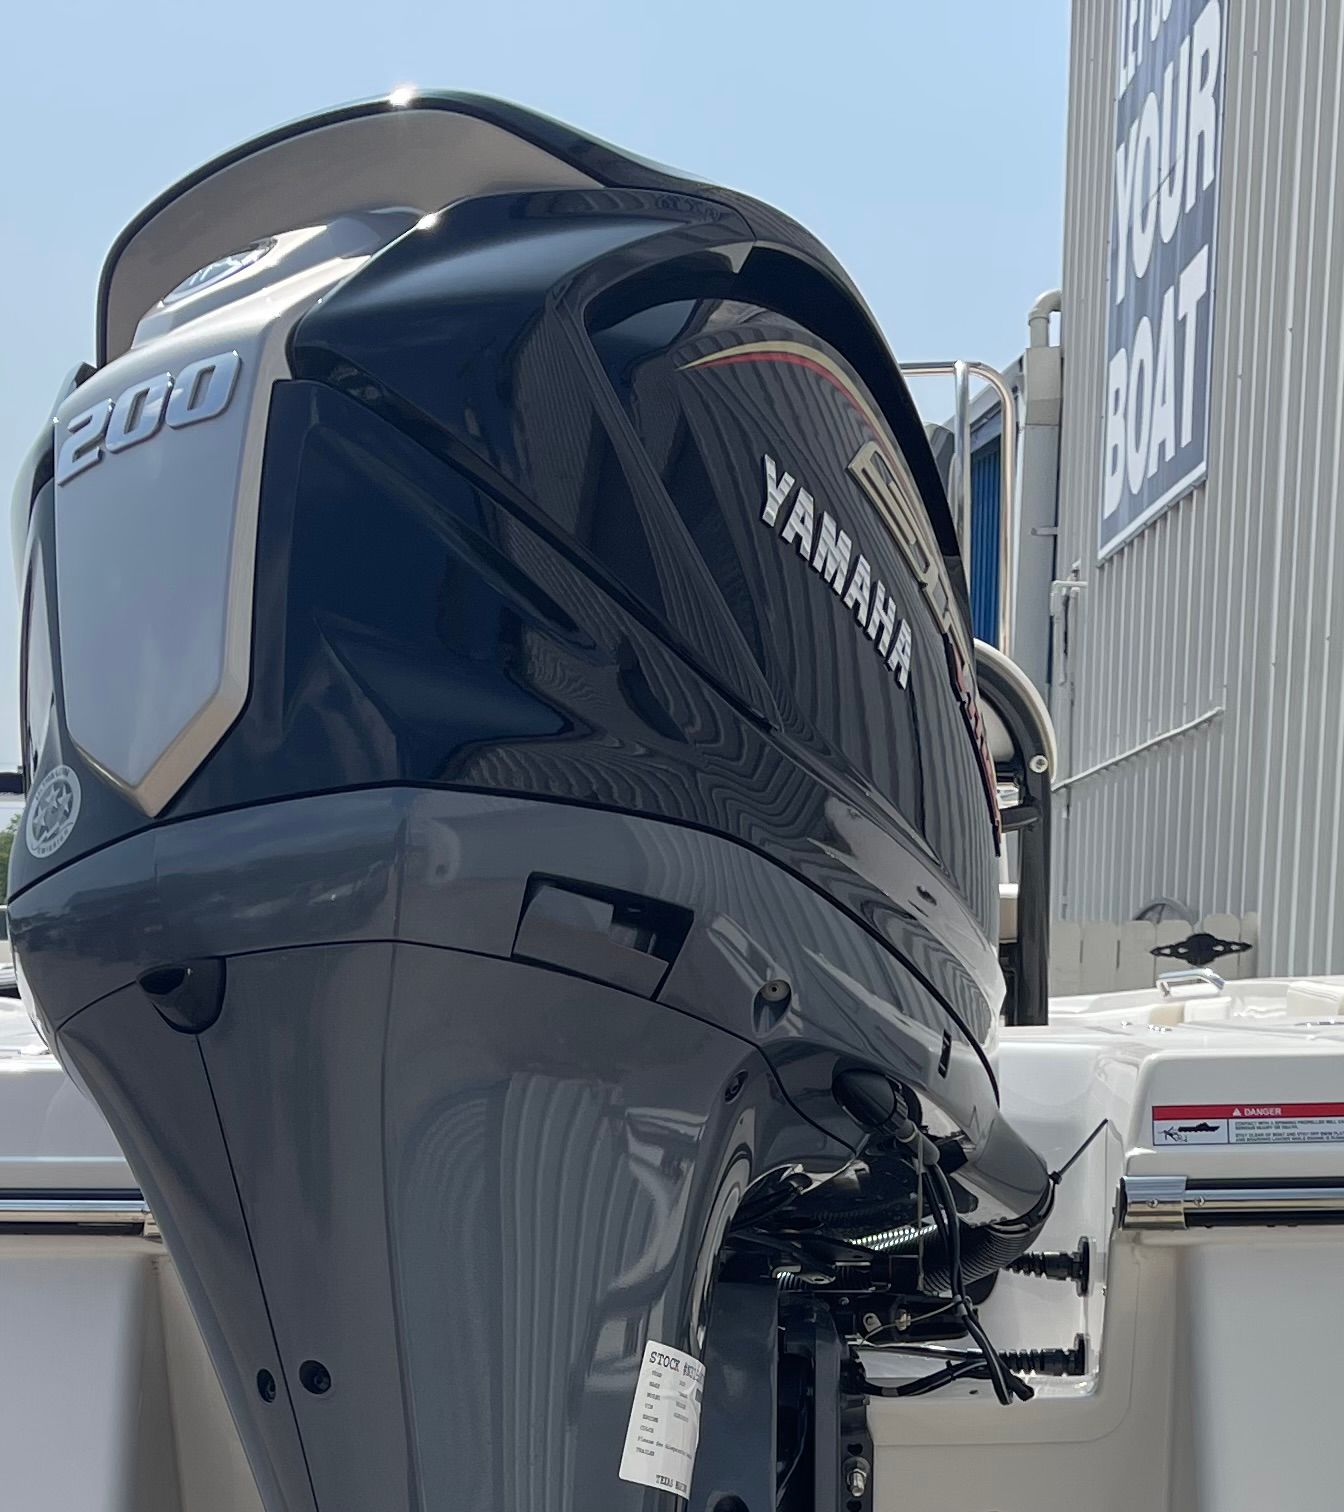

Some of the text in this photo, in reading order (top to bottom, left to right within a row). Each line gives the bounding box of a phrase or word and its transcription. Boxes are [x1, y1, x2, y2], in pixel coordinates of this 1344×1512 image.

[1115, 0, 1221, 305] YOUR
[57, 349, 243, 488] 200
[1103, 244, 1209, 520] BOAT
[760, 453, 913, 691] YAMAHA
[1244, 1108, 1282, 1116] DANGER
[649, 1351, 681, 1373] STOCK
